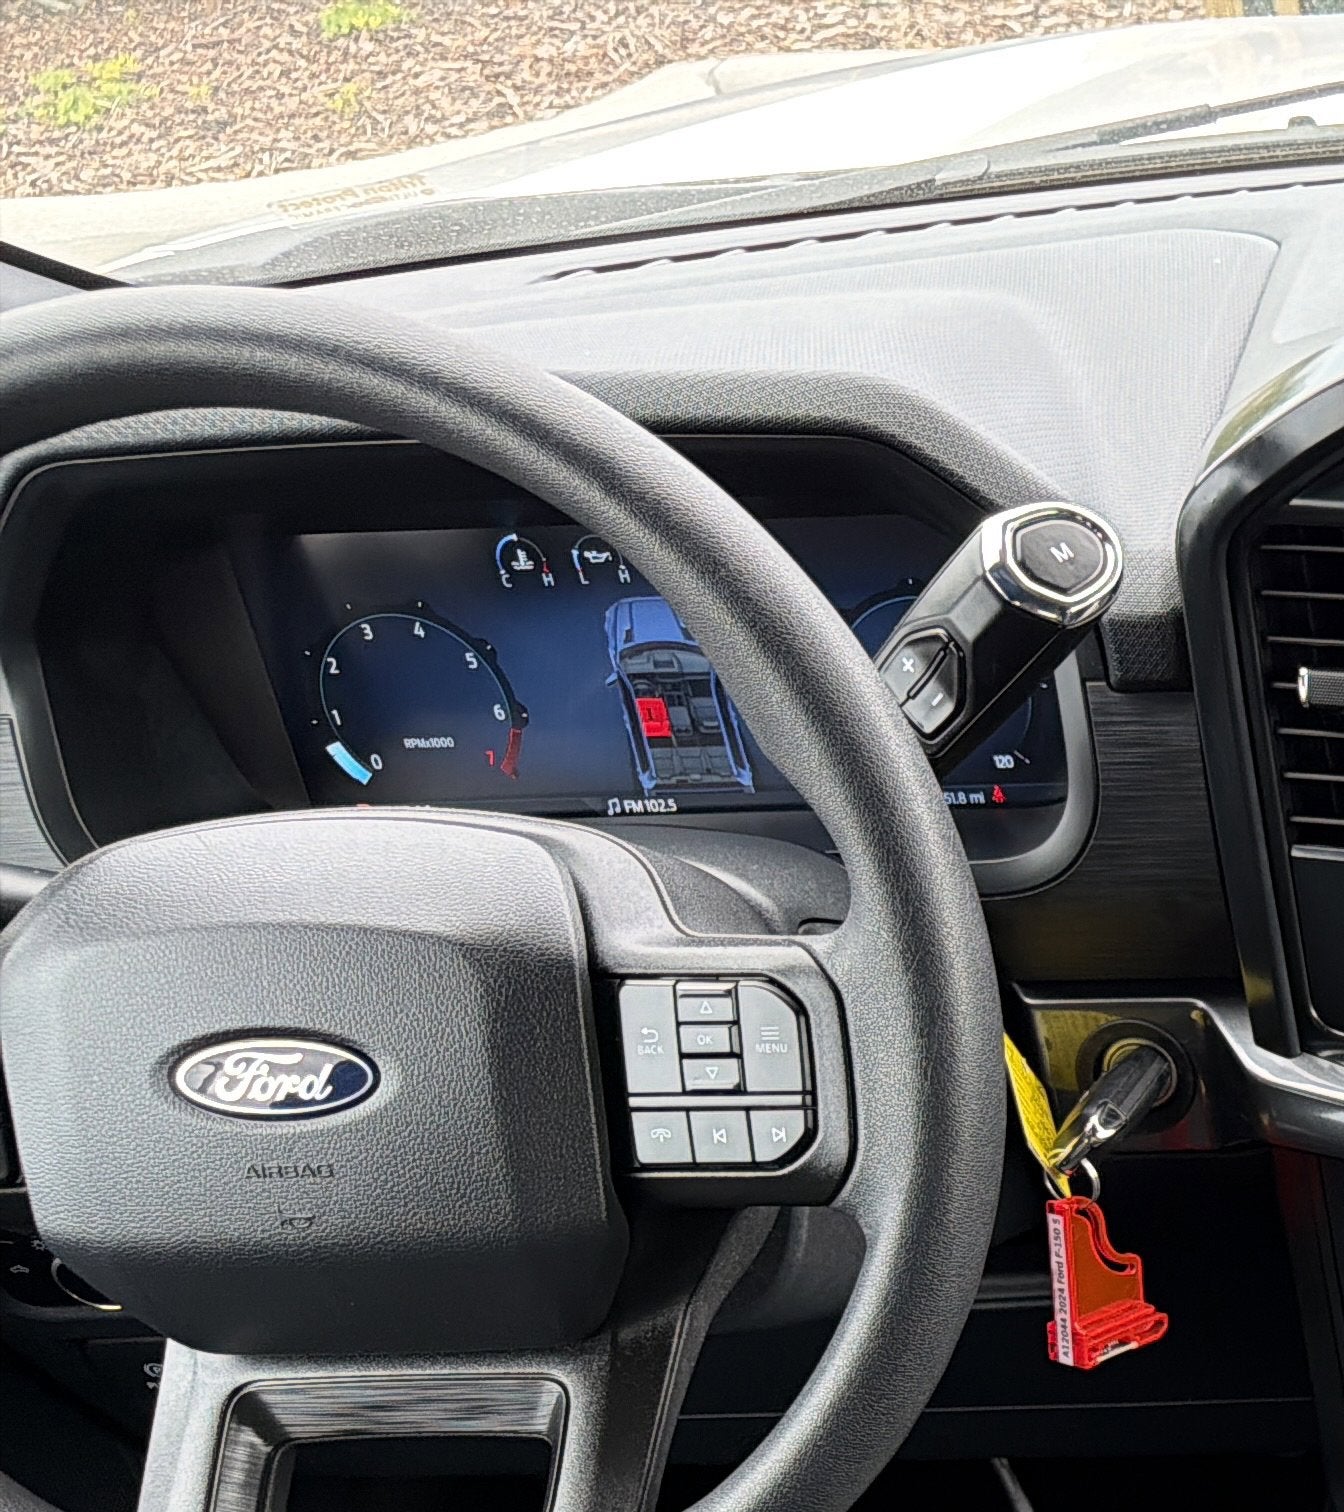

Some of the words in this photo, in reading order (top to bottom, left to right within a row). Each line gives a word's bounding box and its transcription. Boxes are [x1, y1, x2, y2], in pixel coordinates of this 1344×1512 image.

[1050, 541, 1074, 563] M
[501, 574, 513, 588] C
[542, 573, 555, 587] H
[579, 571, 590, 585] L
[618, 569, 631, 584] H
[359, 623, 374, 641] 3
[413, 621, 426, 638] 4
[326, 657, 340, 674] 2
[464, 652, 478, 669] 5
[331, 709, 341, 726] 1
[493, 703, 506, 721] 6
[403, 737, 455, 749] RPMx1000
[370, 753, 383, 770] 0
[993, 754, 1015, 769] 120
[623, 799, 644, 813] FM
[644, 798, 678, 812] 102.5
[969, 791, 986, 805] mi
[697, 1034, 713, 1045] OK
[637, 1045, 664, 1055] BACK
[755, 1043, 788, 1053] MENU
[214, 1051, 334, 1101] Ford
[245, 1163, 335, 1179] AIRBAG
[1053, 1228, 1064, 1259] F-150
[1056, 1261, 1066, 1285] Ford
[1058, 1287, 1068, 1314] 2024
